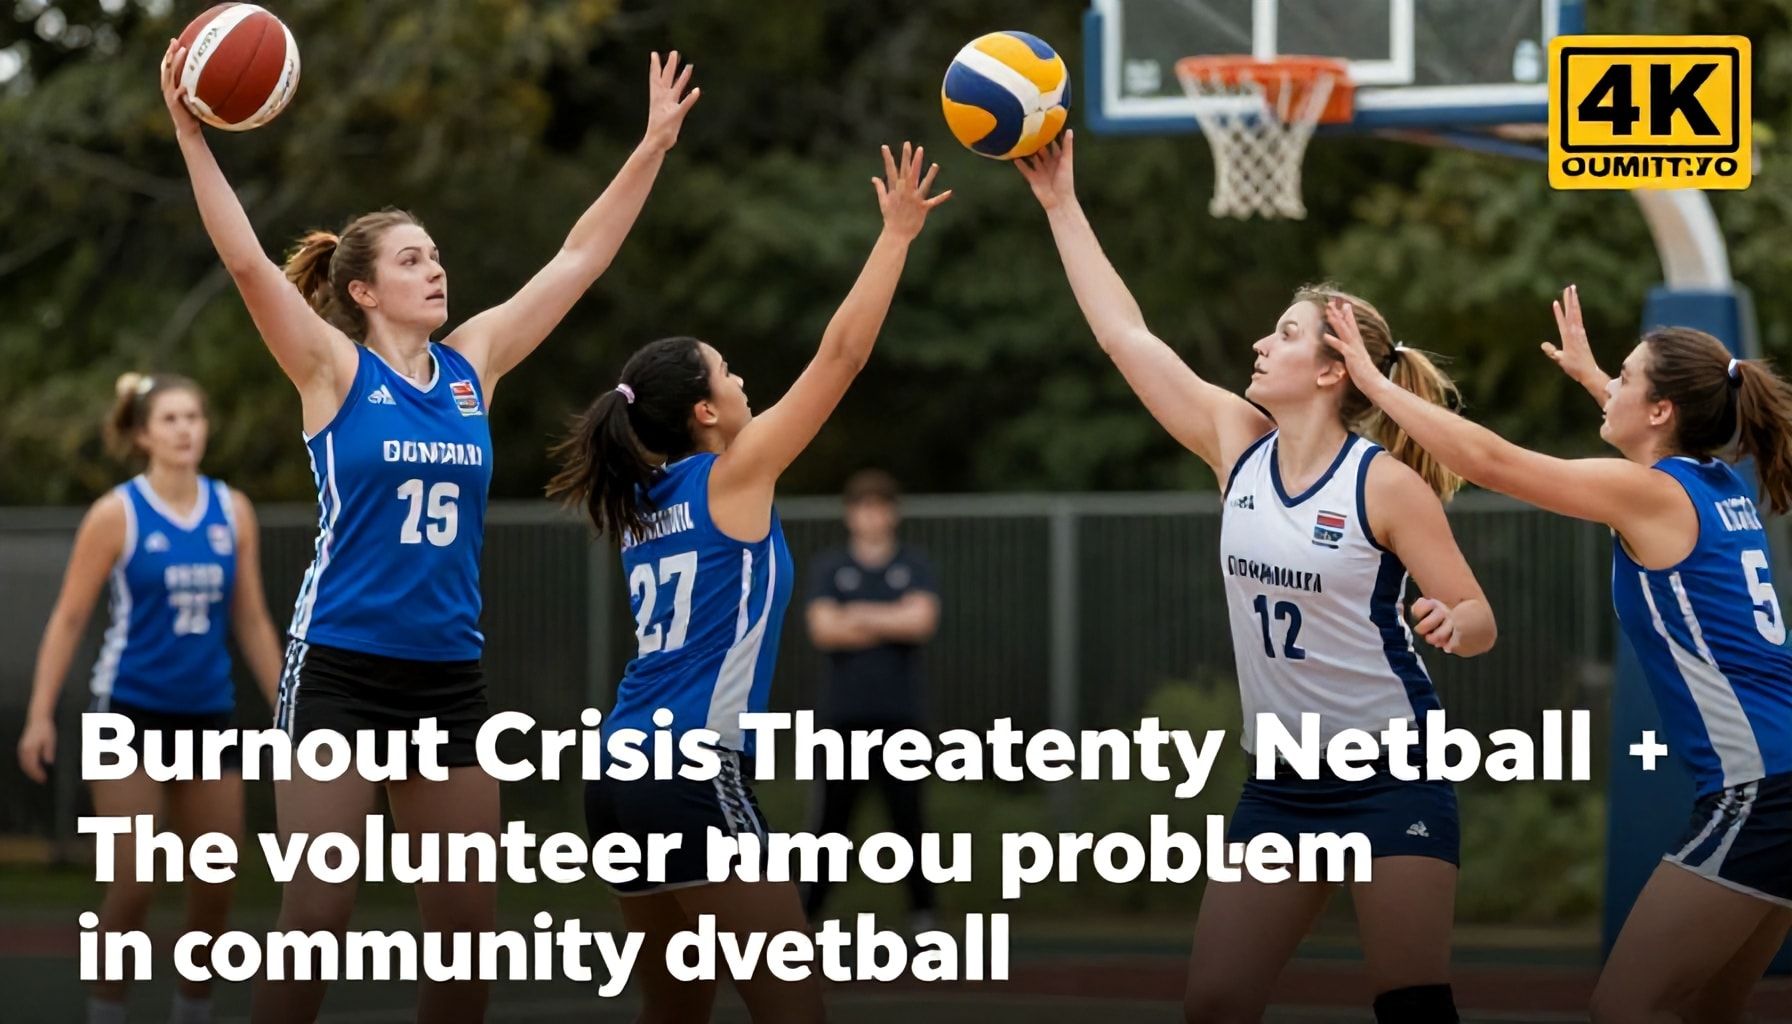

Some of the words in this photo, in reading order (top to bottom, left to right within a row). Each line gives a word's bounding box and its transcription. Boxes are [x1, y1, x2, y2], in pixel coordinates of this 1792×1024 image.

[629, 550, 698, 660] 27
[1253, 594, 1307, 660] 12
[1741, 549, 1786, 646] 5
